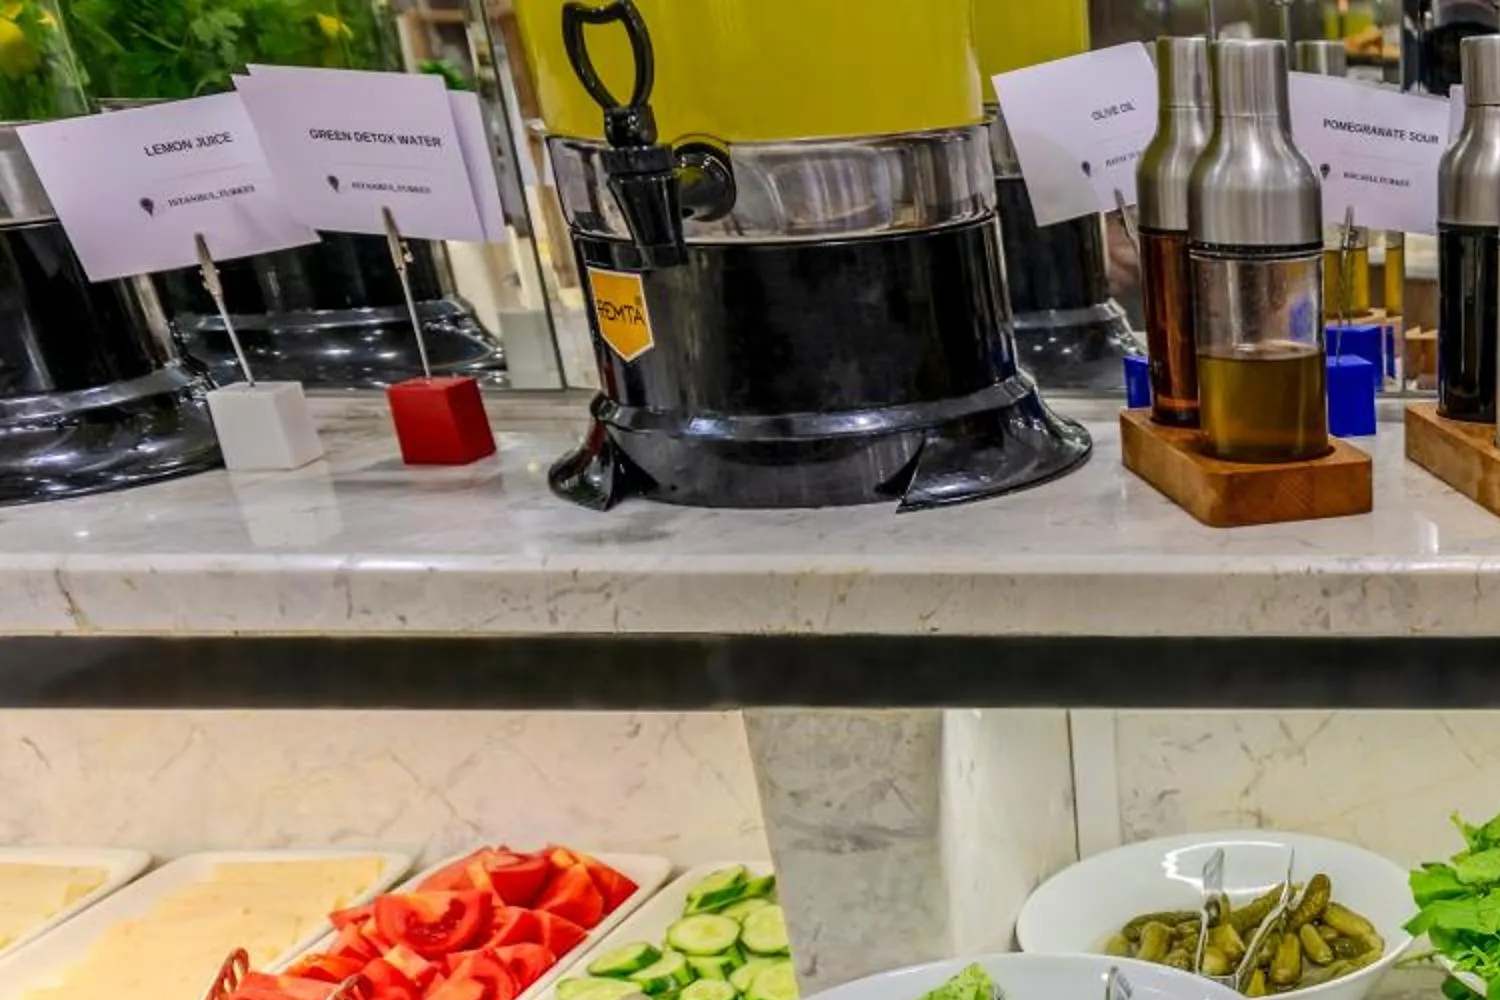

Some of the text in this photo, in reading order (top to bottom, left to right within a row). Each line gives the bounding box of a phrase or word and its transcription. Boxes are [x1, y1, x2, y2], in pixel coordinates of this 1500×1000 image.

[1090, 101, 1137, 121] OLIVE OIL
[309, 128, 442, 148] GREEN DETOX WATER
[1323, 118, 1439, 145] POMEGRANATE SOUR
[143, 131, 234, 157] LEMON JUICE
